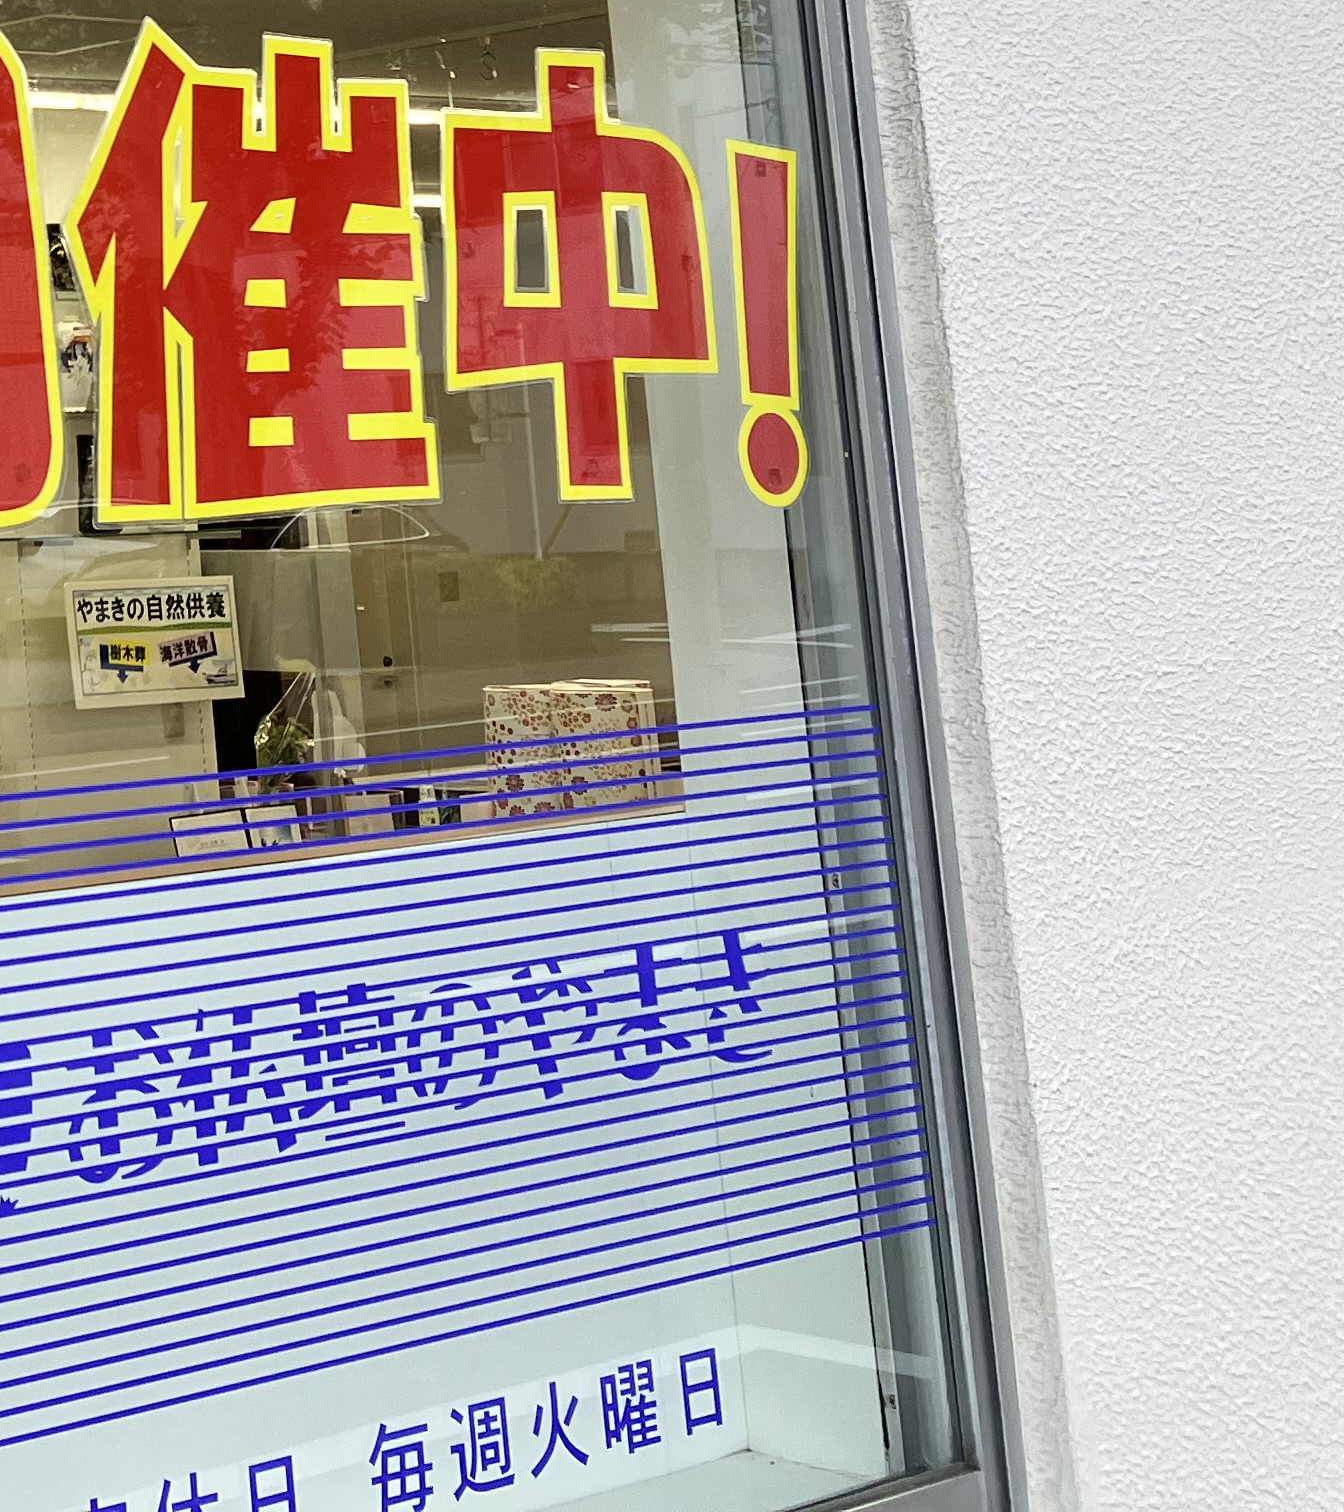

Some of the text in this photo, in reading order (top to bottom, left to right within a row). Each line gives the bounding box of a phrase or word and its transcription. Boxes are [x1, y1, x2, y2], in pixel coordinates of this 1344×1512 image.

[77, 592, 226, 623] やまきの自然供養
[160, 635, 209, 662] 海洋散骨
[369, 1347, 725, 1512] 毎週火曜日
